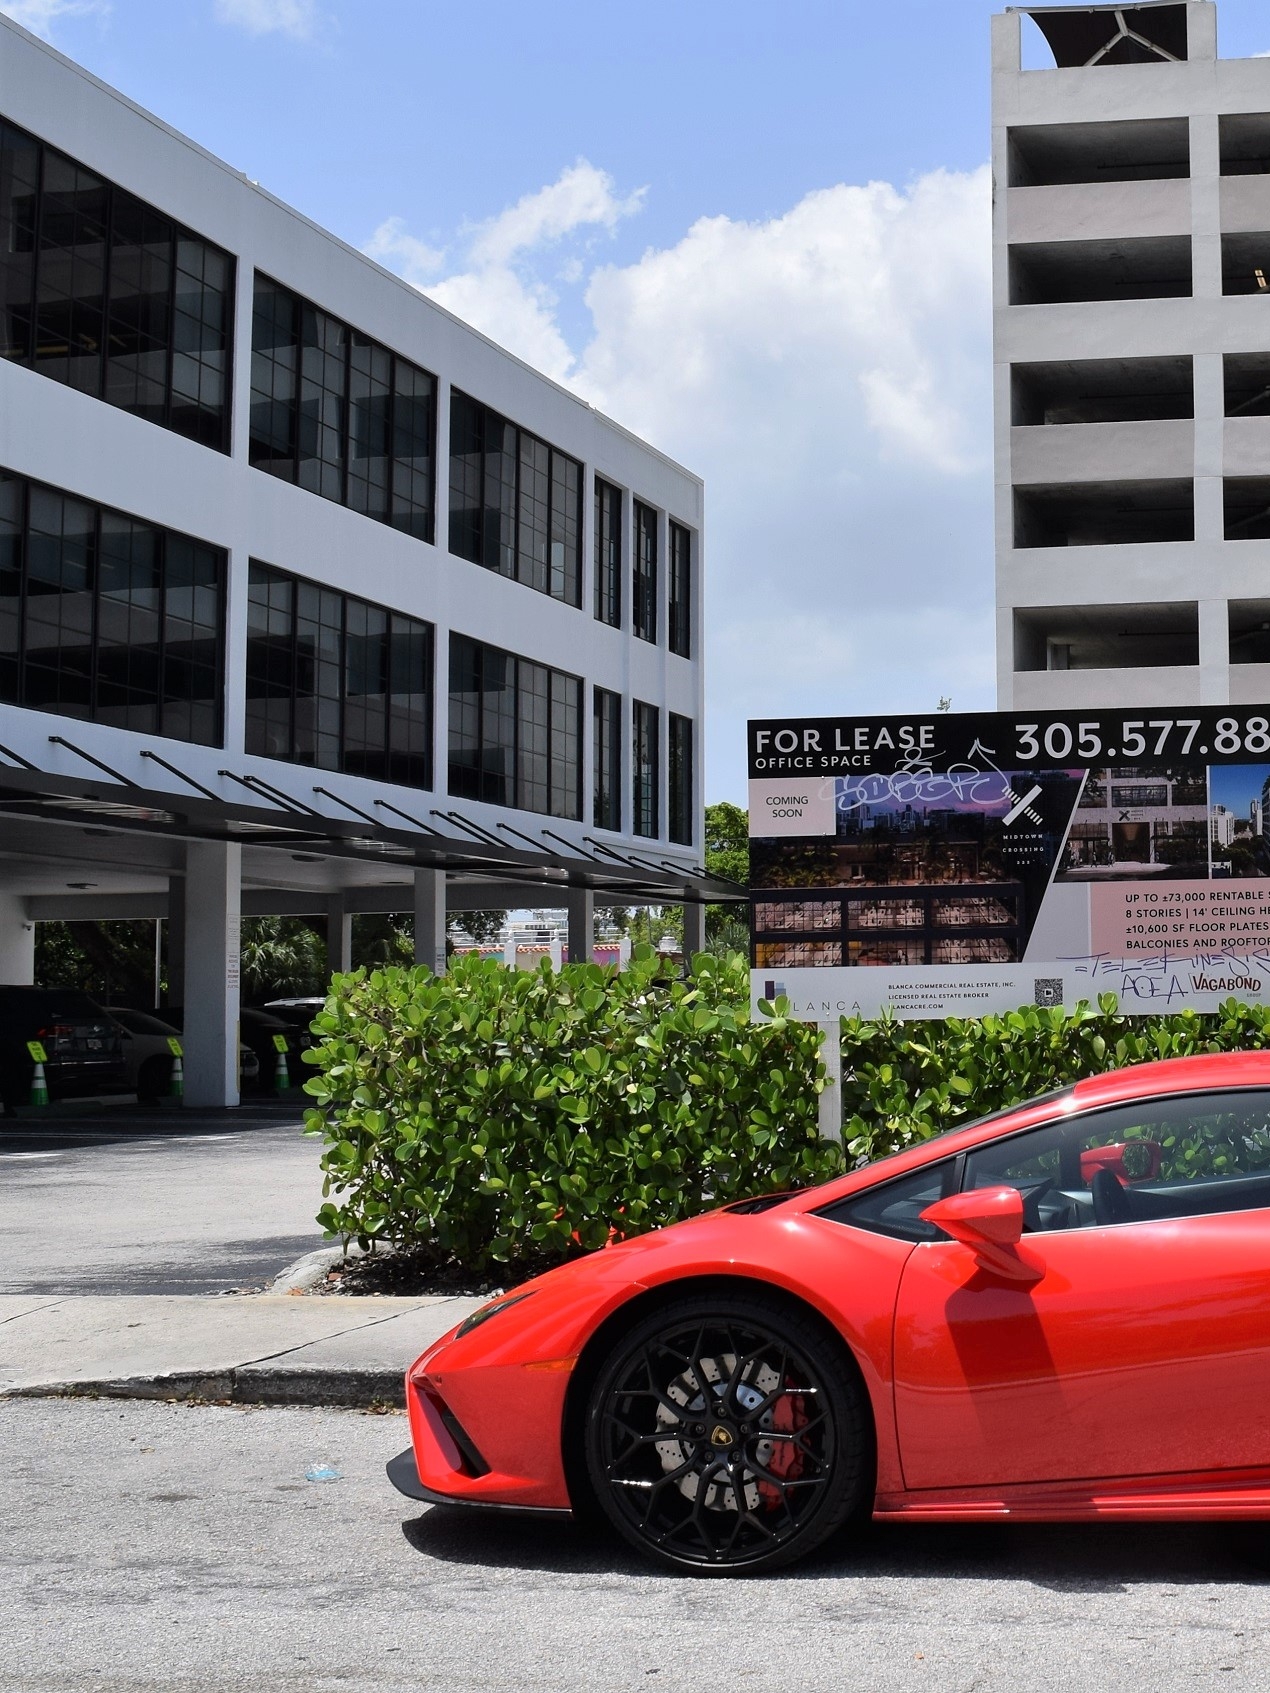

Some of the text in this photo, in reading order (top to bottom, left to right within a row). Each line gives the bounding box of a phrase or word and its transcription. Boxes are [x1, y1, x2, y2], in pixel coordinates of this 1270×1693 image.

[756, 725, 935, 753] FOR LEASE
[755, 755, 871, 769] OFFICE SPACE
[765, 796, 809, 806] COMING
[772, 808, 803, 818] SOON
[1125, 894, 1139, 903] UP
[1143, 894, 1158, 902] TO
[1162, 892, 1206, 903] ±73,000
[1209, 891, 1264, 901] RENTABLE
[1125, 909, 1132, 919] 8
[1136, 908, 1182, 918] STORIES
[1192, 908, 1208, 917] 14'
[1211, 907, 1256, 916] CEILING
[1125, 922, 1269, 934] ±10,600 SF FLOOR PLATES
[1126, 939, 1189, 949] BALCONIES
[1193, 938, 1217, 948] AND
[1192, 973, 1262, 992] VAGABOND
[793, 1001, 861, 1012] LANCA
